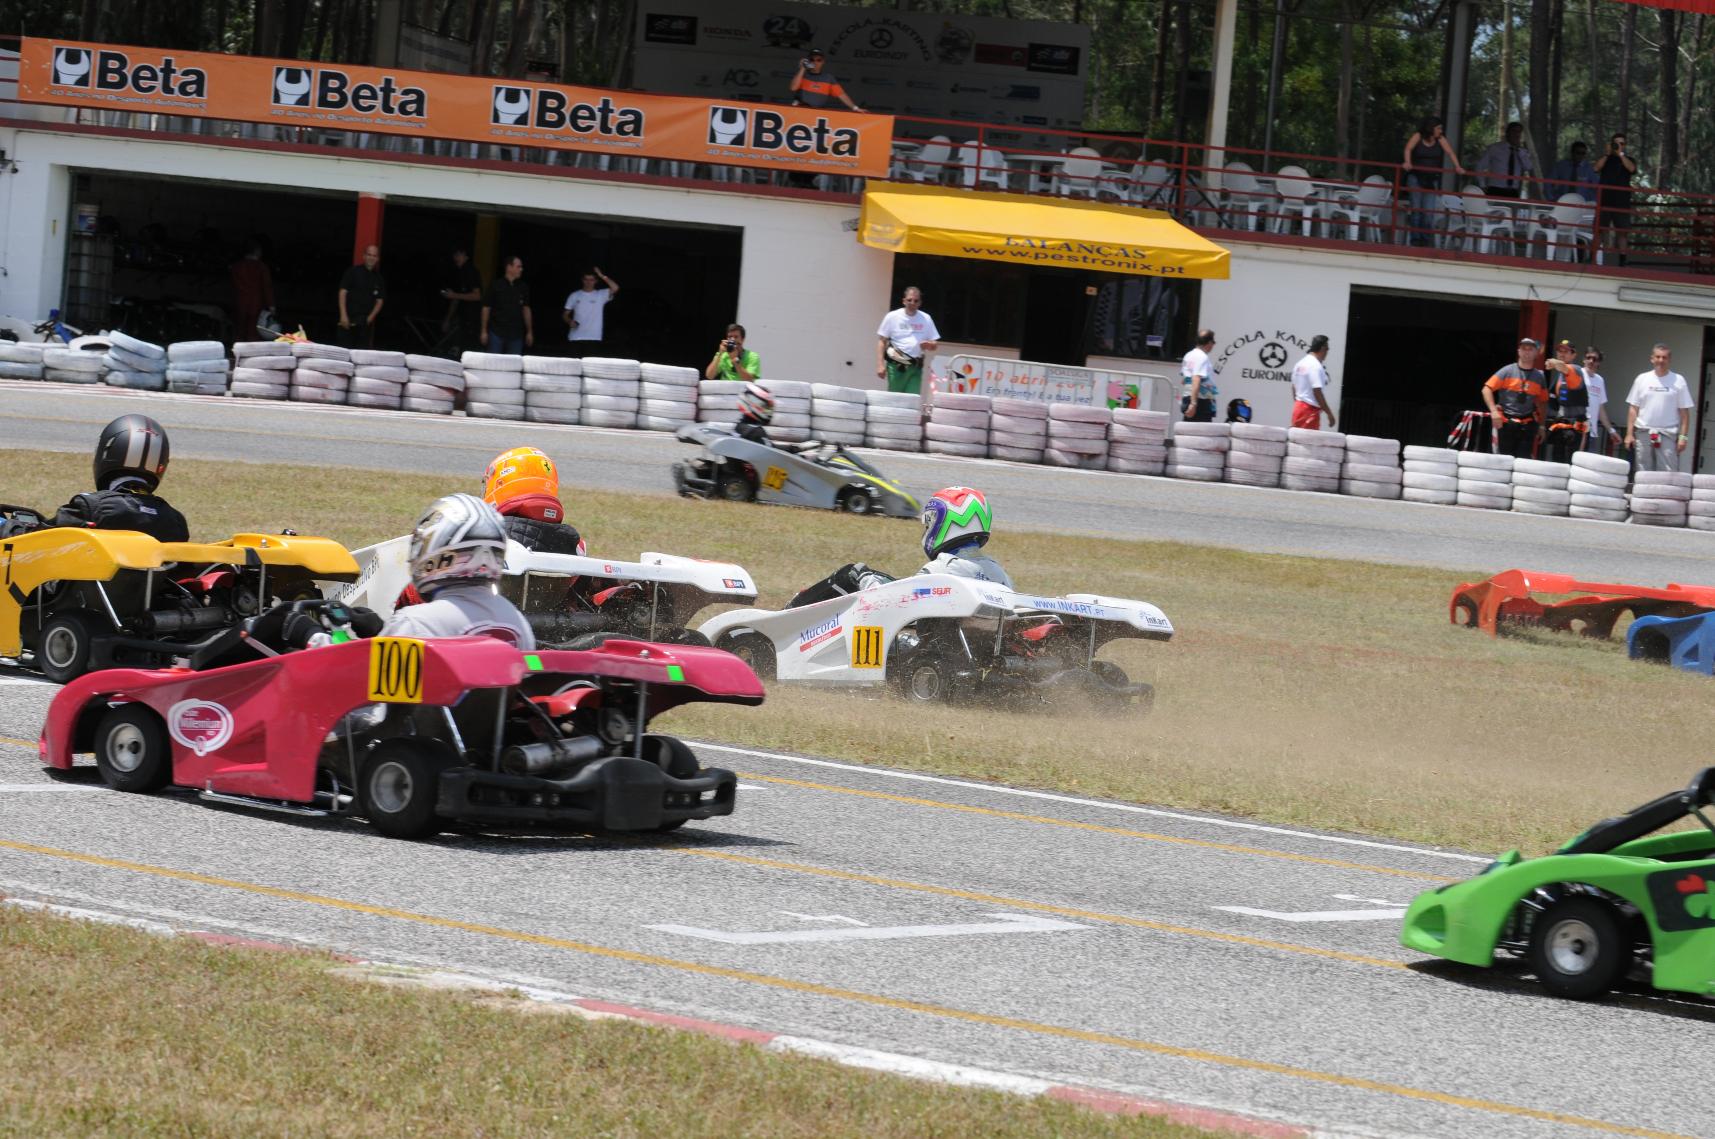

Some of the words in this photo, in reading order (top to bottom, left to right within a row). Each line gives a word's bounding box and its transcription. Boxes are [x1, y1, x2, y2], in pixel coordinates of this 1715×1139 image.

[769, 16, 801, 33] 24
[828, 17, 874, 56] ESCOLA
[882, 17, 932, 62] KARTING
[96, 50, 207, 99] Beta
[316, 69, 427, 118] Beta
[534, 89, 644, 138] Beta
[751, 109, 860, 158] Beta
[962, 245, 1185, 275] www.pestronix.pt
[1213, 330, 1266, 375] ESCOLA
[1241, 368, 1292, 382] EUROIN
[986, 370, 1004, 382] 10
[800, 612, 840, 644] Mucoral
[854, 629, 880, 666] 111
[373, 641, 420, 698] 100
